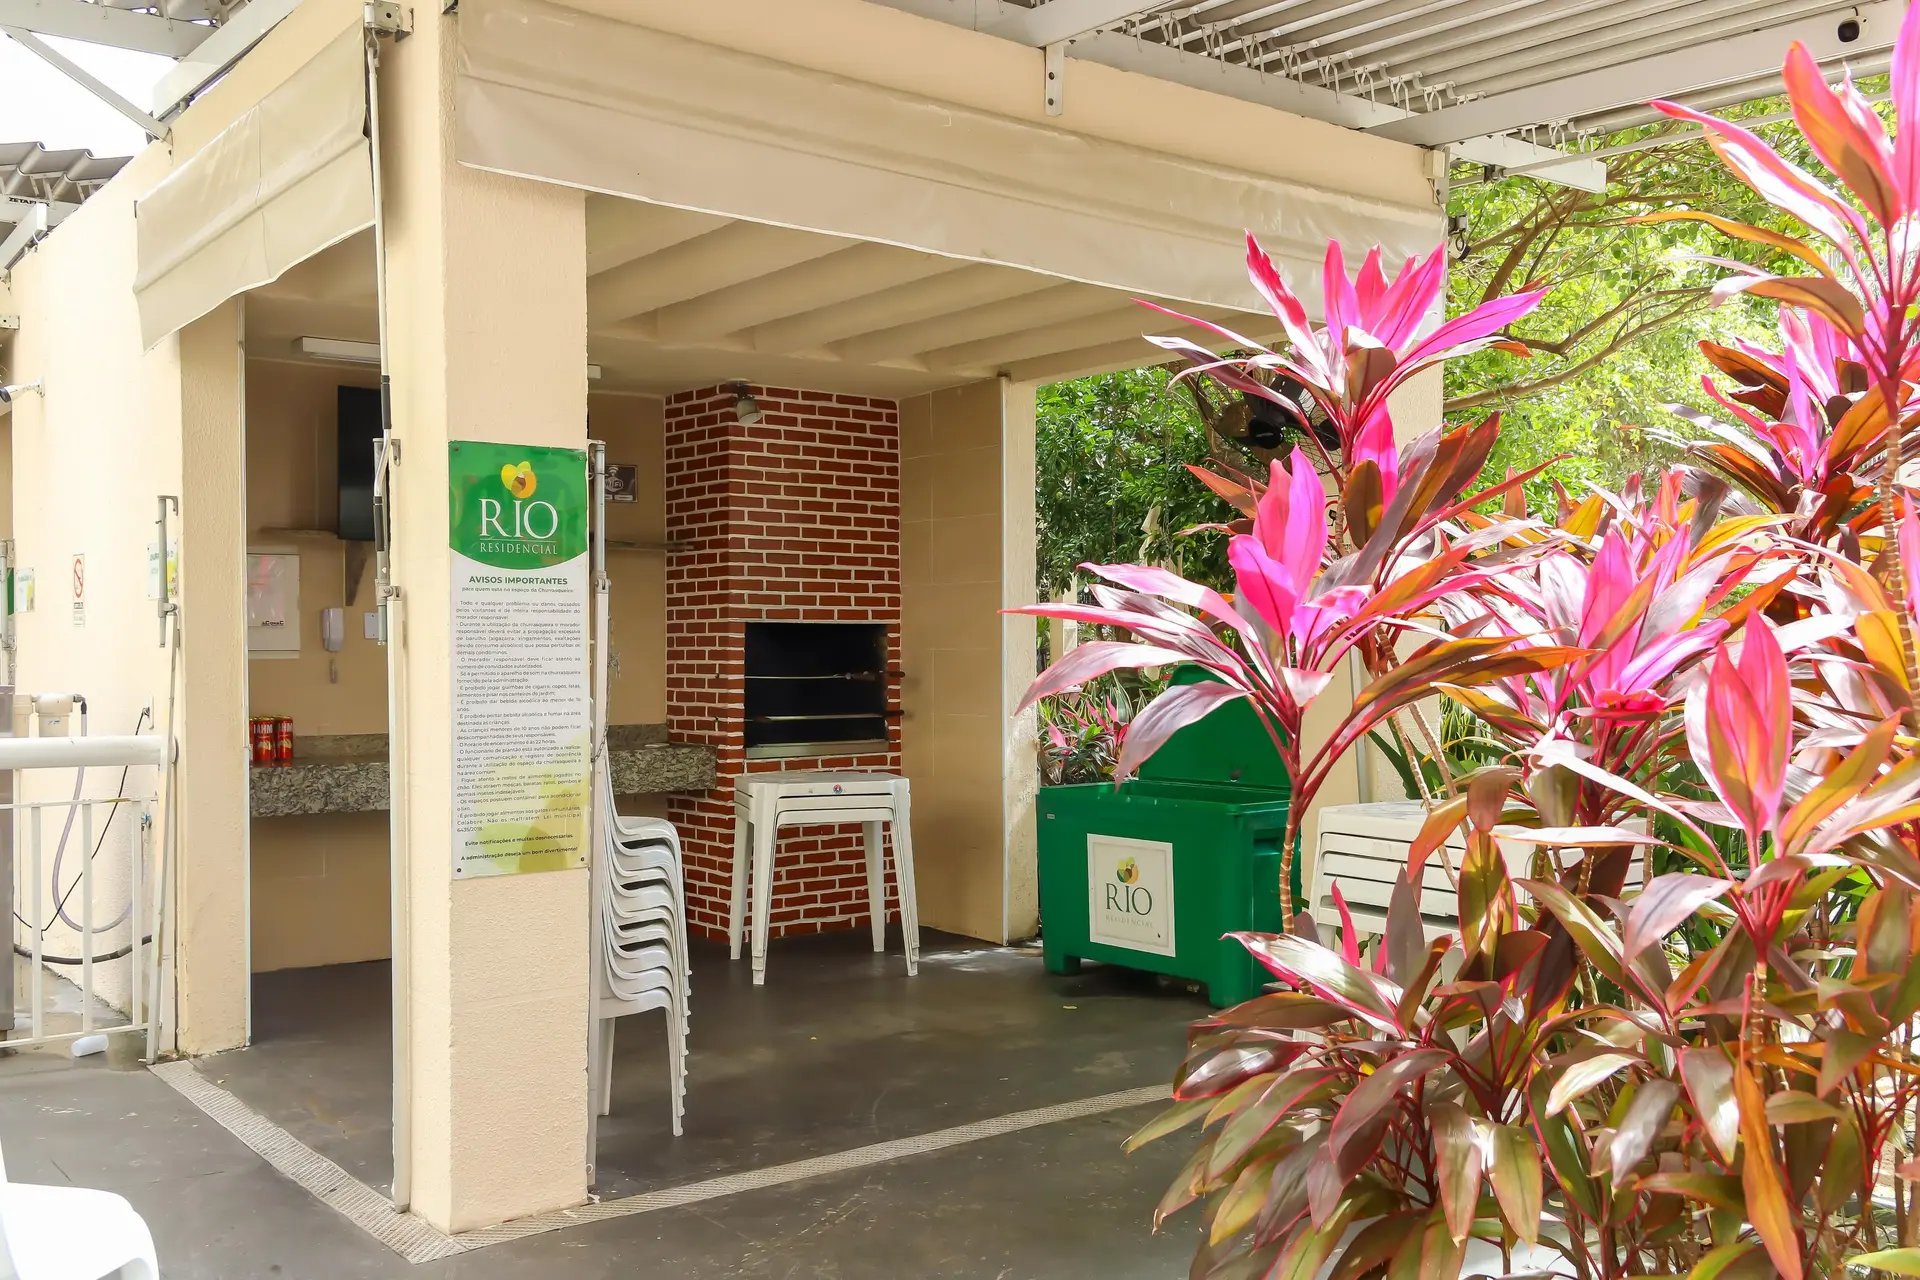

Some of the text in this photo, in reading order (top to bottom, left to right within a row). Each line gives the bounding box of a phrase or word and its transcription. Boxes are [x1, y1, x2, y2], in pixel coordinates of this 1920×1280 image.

[479, 498, 558, 539] RIO
[480, 542, 558, 554] RESIDENCIAL
[1106, 882, 1152, 916] RIO
